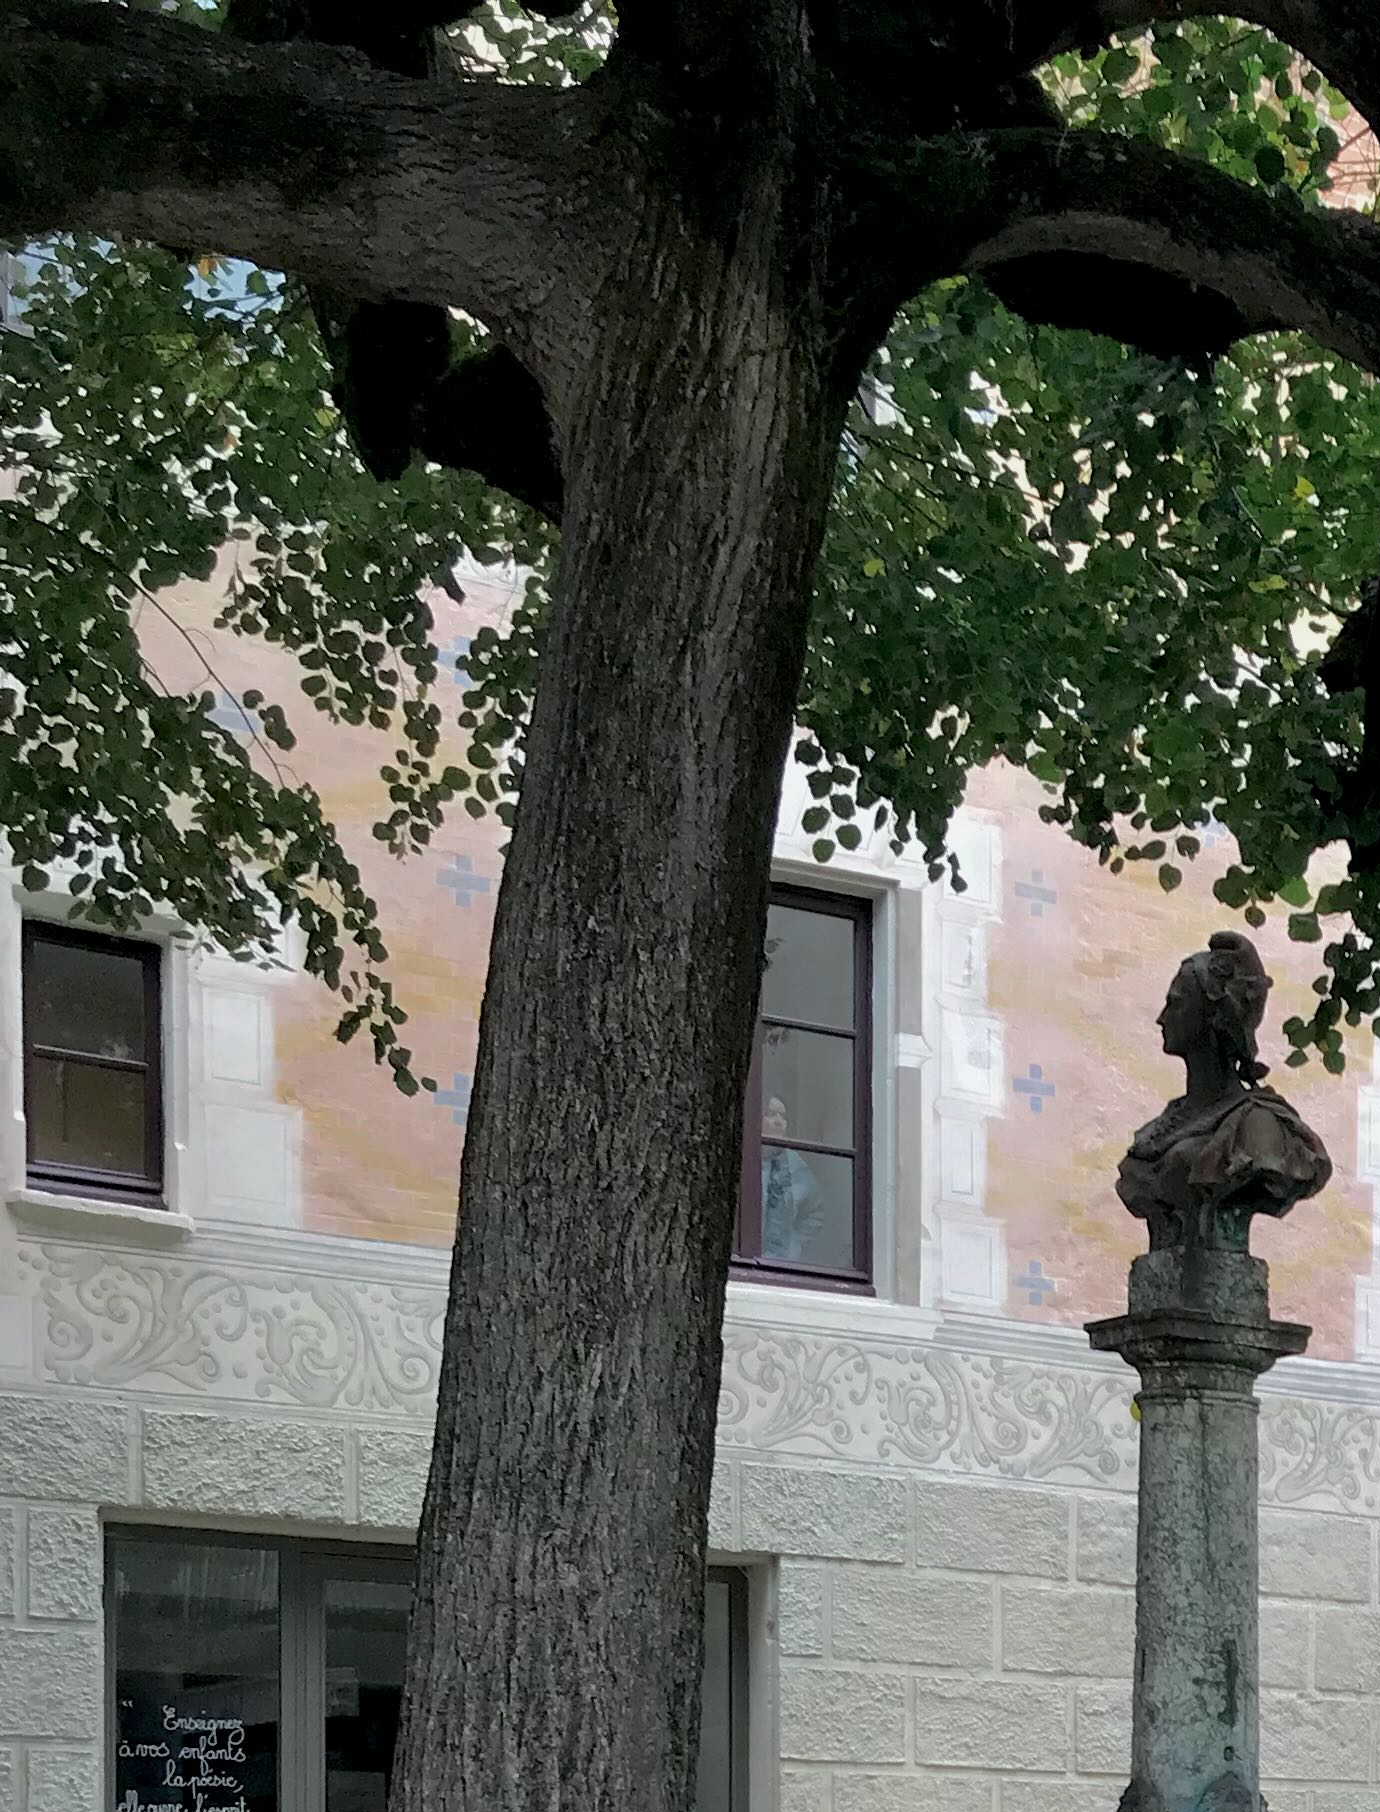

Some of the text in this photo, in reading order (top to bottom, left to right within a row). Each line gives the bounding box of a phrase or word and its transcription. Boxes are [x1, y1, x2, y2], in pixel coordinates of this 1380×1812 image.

[162, 1704, 246, 1746] Enseignez
[136, 1742, 170, 1757] vos
[178, 1736, 247, 1776] enfants
[162, 1759, 187, 1787] la
